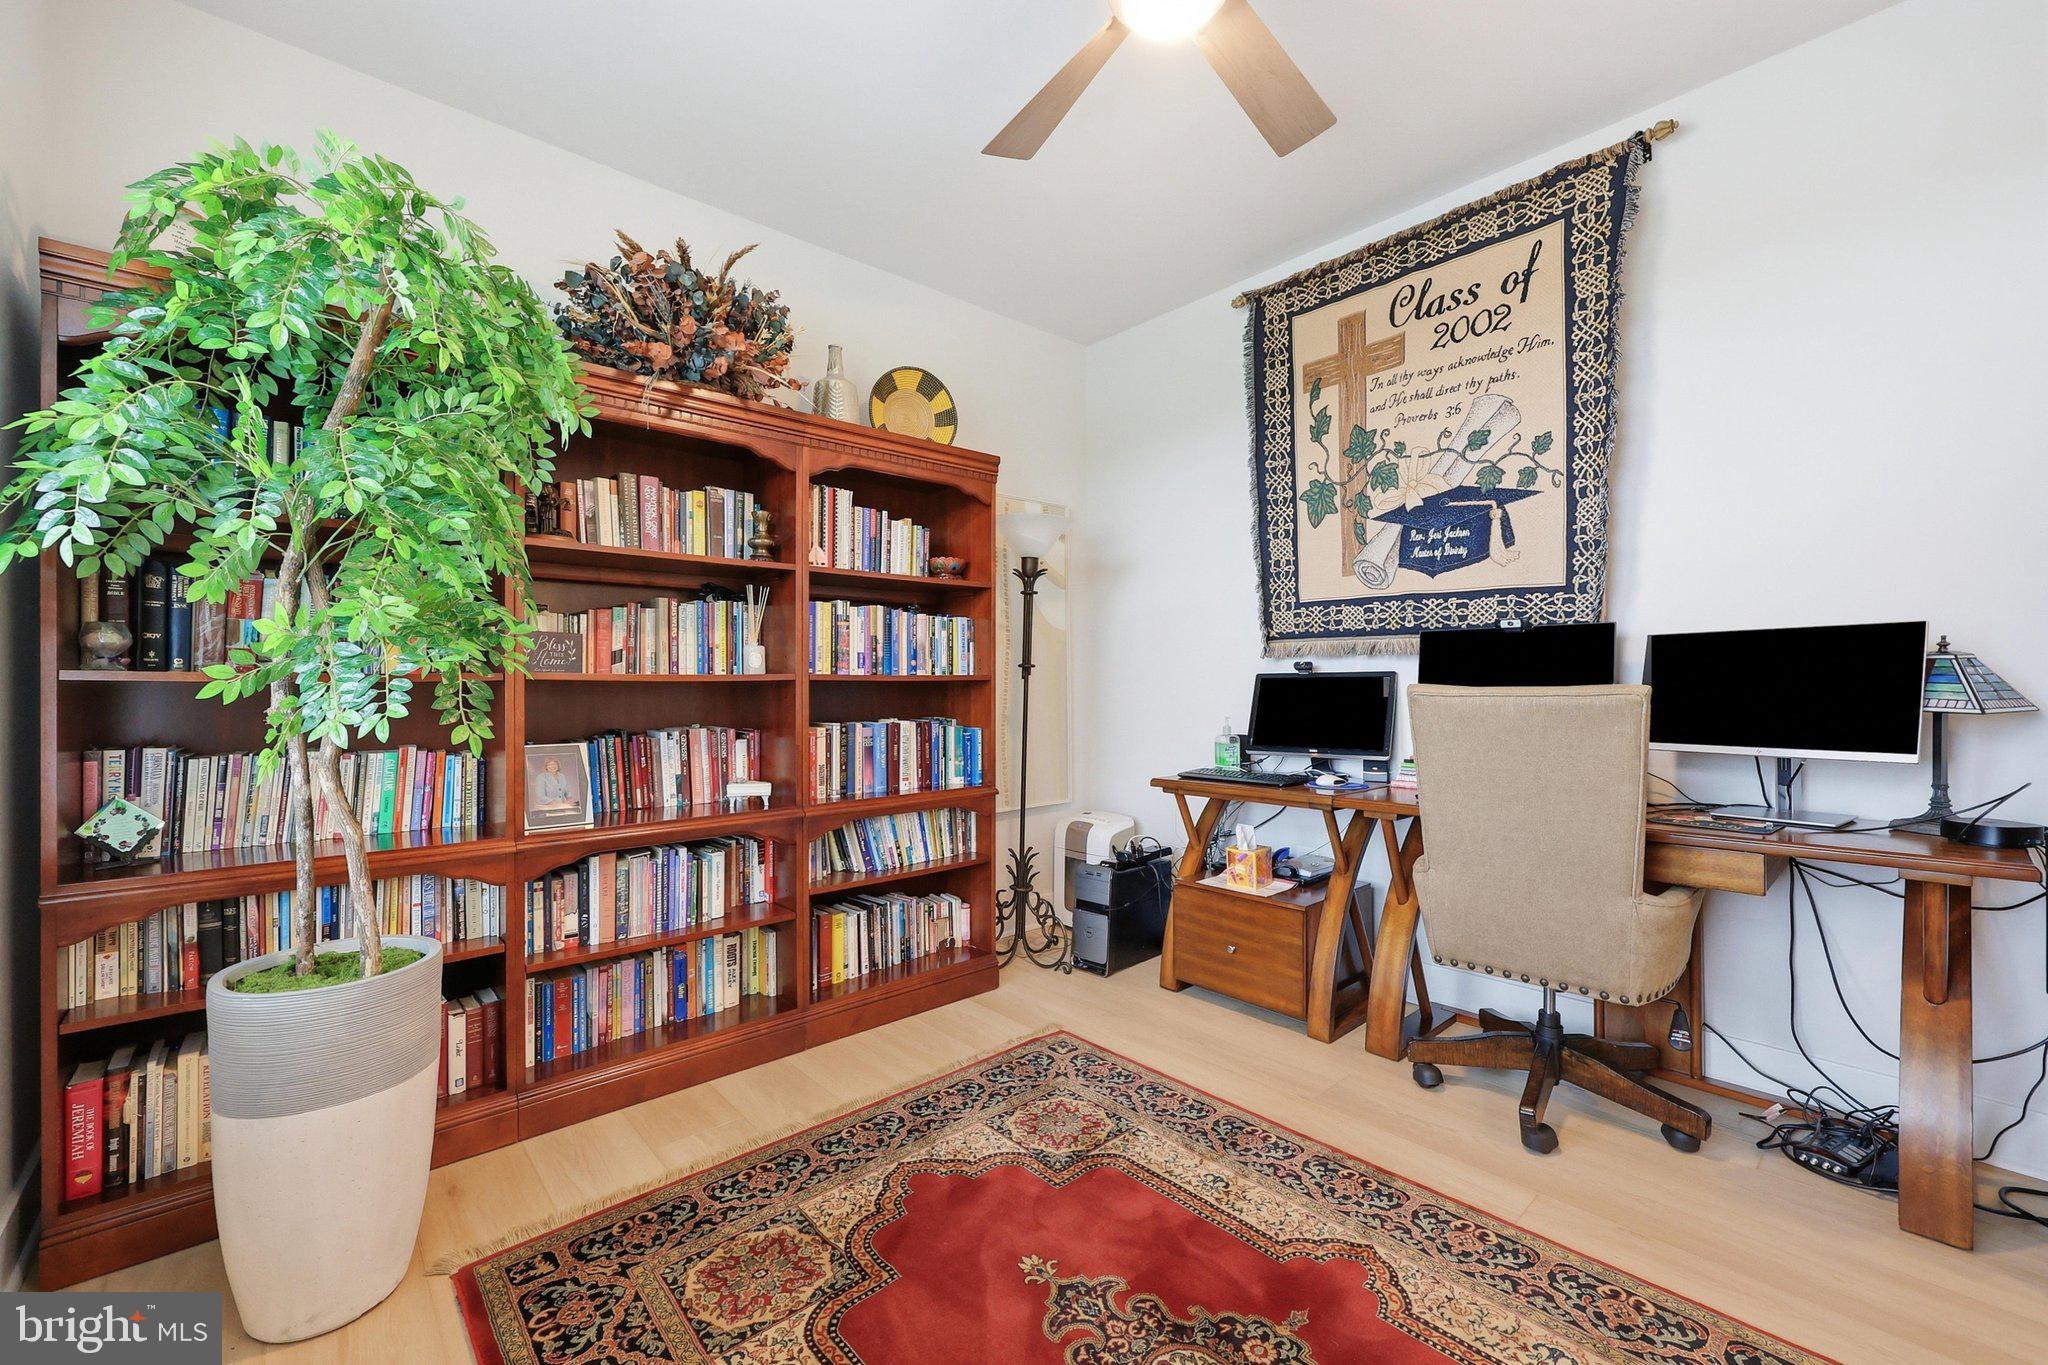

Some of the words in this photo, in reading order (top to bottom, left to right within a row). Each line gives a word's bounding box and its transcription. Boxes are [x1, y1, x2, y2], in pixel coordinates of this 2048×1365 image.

[1389, 277, 1481, 327] Class
[1500, 239, 1542, 304] of
[1430, 303, 1512, 351] 2002
[1369, 376, 1384, 392] In
[1386, 372, 1398, 386] all
[1399, 370, 1414, 387] thy
[1417, 366, 1445, 381] ways
[1447, 345, 1514, 371] acknowledge
[1517, 333, 1555, 355] Him.
[1369, 401, 1387, 414] and
[1388, 391, 1408, 409] He
[1409, 387, 1433, 403] shall
[1435, 383, 1462, 397] direct
[1465, 378, 1484, 395] thy
[1485, 368, 1521, 394] paths.
[1393, 409, 1439, 429] Proverbs
[1444, 401, 1462, 418] 3:6
[630, 478, 638, 515] AMERICAN
[632, 516, 640, 546] SOLDIER
[1434, 546, 1442, 561] of
[534, 634, 566, 652] Bless
[532, 650, 567, 668] Home
[680, 734, 688, 761] GENESIS
[720, 732, 728, 759] GENESIS
[108, 754, 122, 783] TERRY
[727, 943, 737, 968] ROOTS
[202, 1065, 211, 1119] REVELATION
[86, 1107, 95, 1121] THE
[71, 1103, 85, 1161] JEREMIAH
[86, 1122, 95, 1142] BOOK
[86, 1142, 95, 1152] OF
